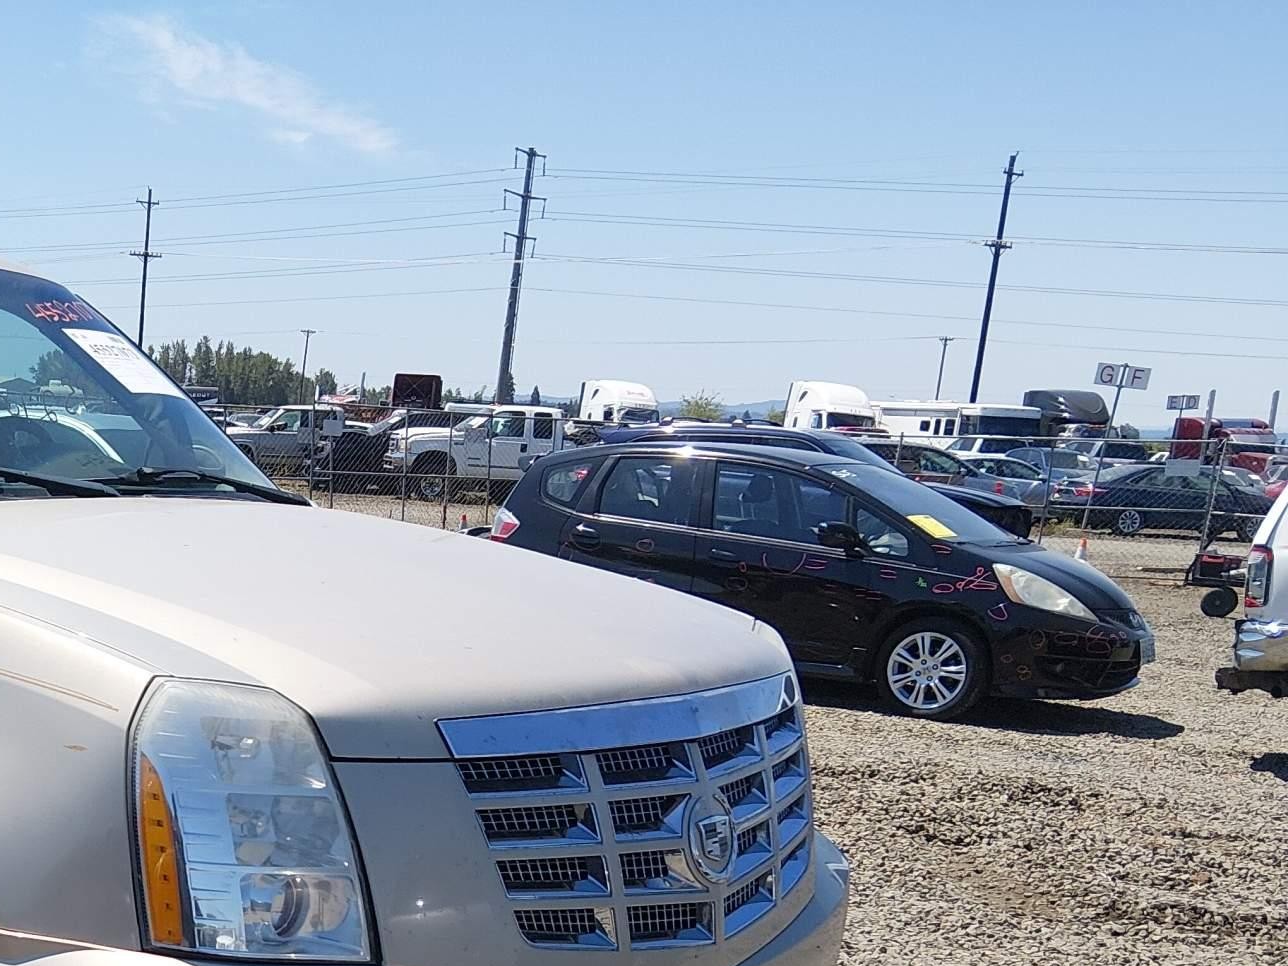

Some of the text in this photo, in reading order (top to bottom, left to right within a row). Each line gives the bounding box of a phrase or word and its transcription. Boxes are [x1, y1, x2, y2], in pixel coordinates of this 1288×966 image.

[1100, 365, 1145, 386] G F
[1169, 397, 1197, 409] E D
